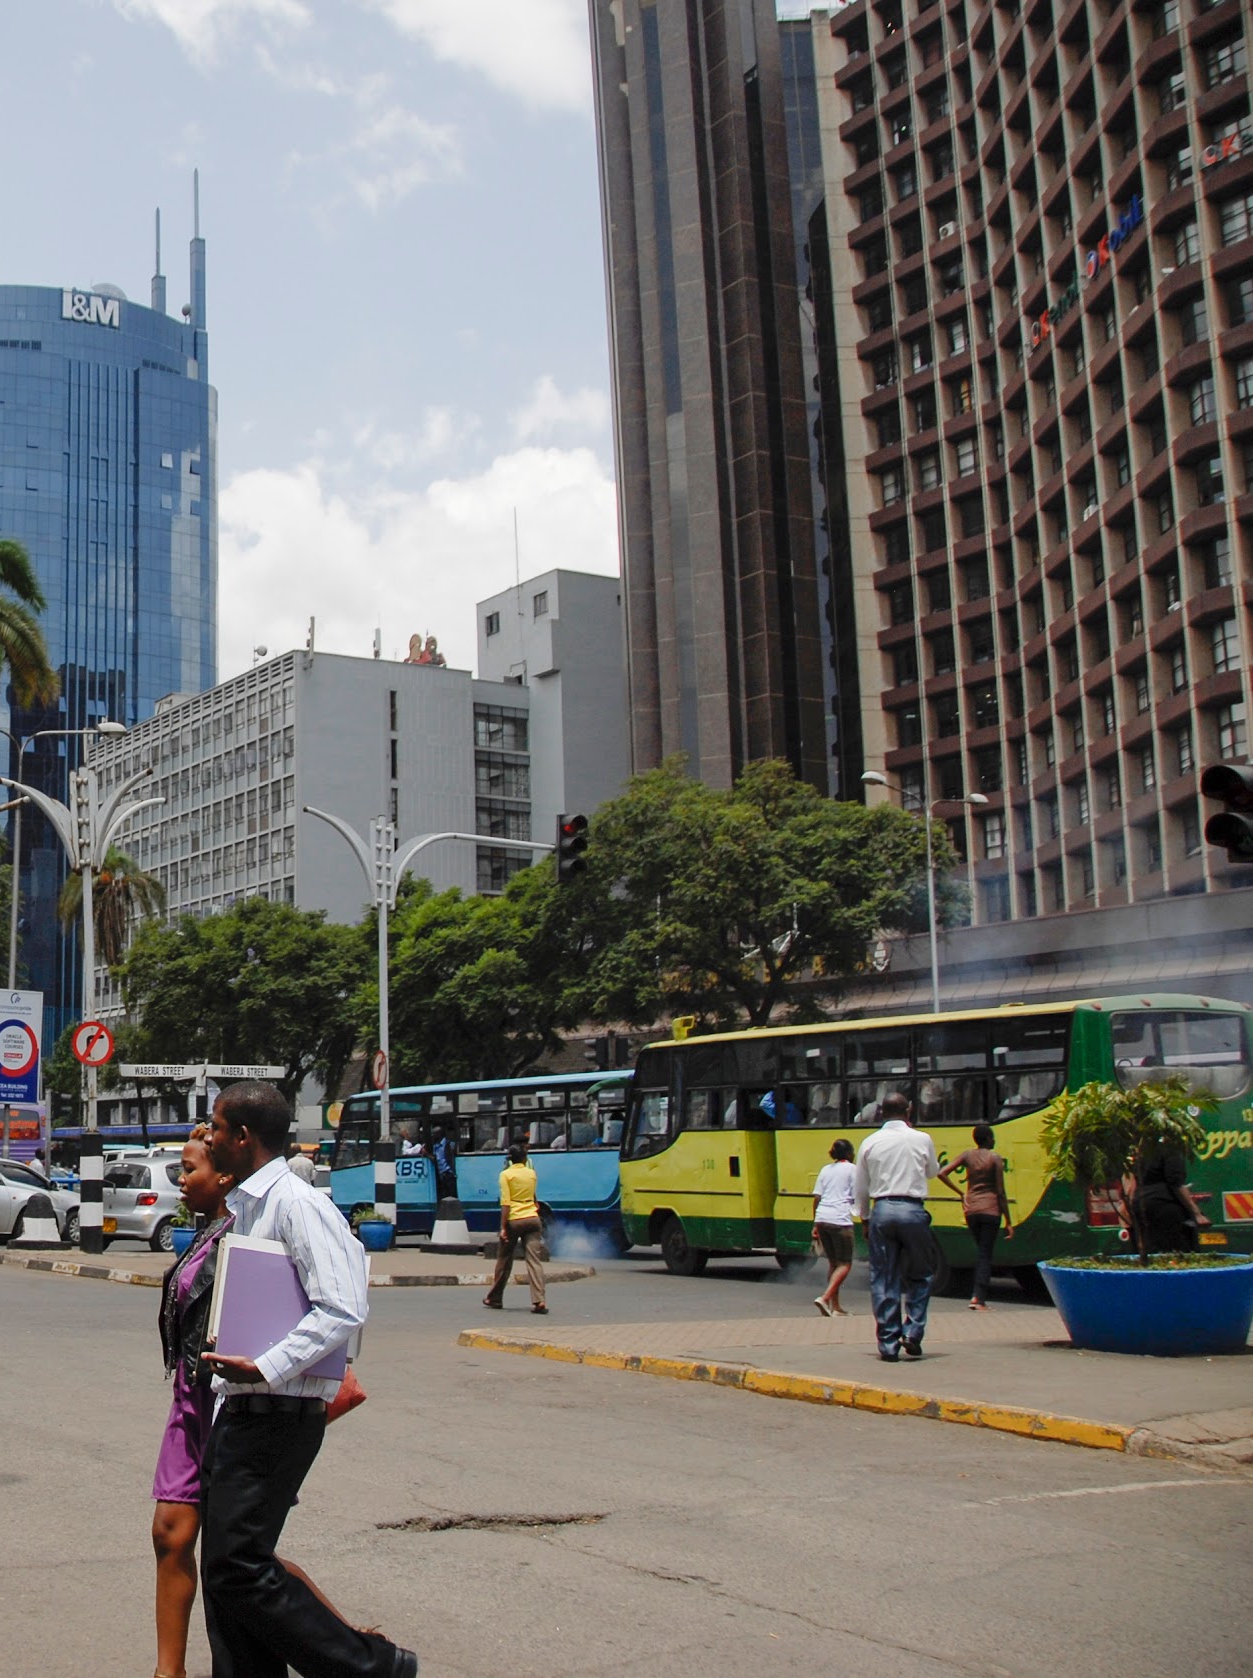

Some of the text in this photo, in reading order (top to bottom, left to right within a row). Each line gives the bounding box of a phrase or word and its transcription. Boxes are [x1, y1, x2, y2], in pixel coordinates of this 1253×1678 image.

[62, 287, 120, 328] I&M
[134, 1066, 185, 1076] WABERA STREET
[221, 1066, 268, 1077] WABERA STREET
